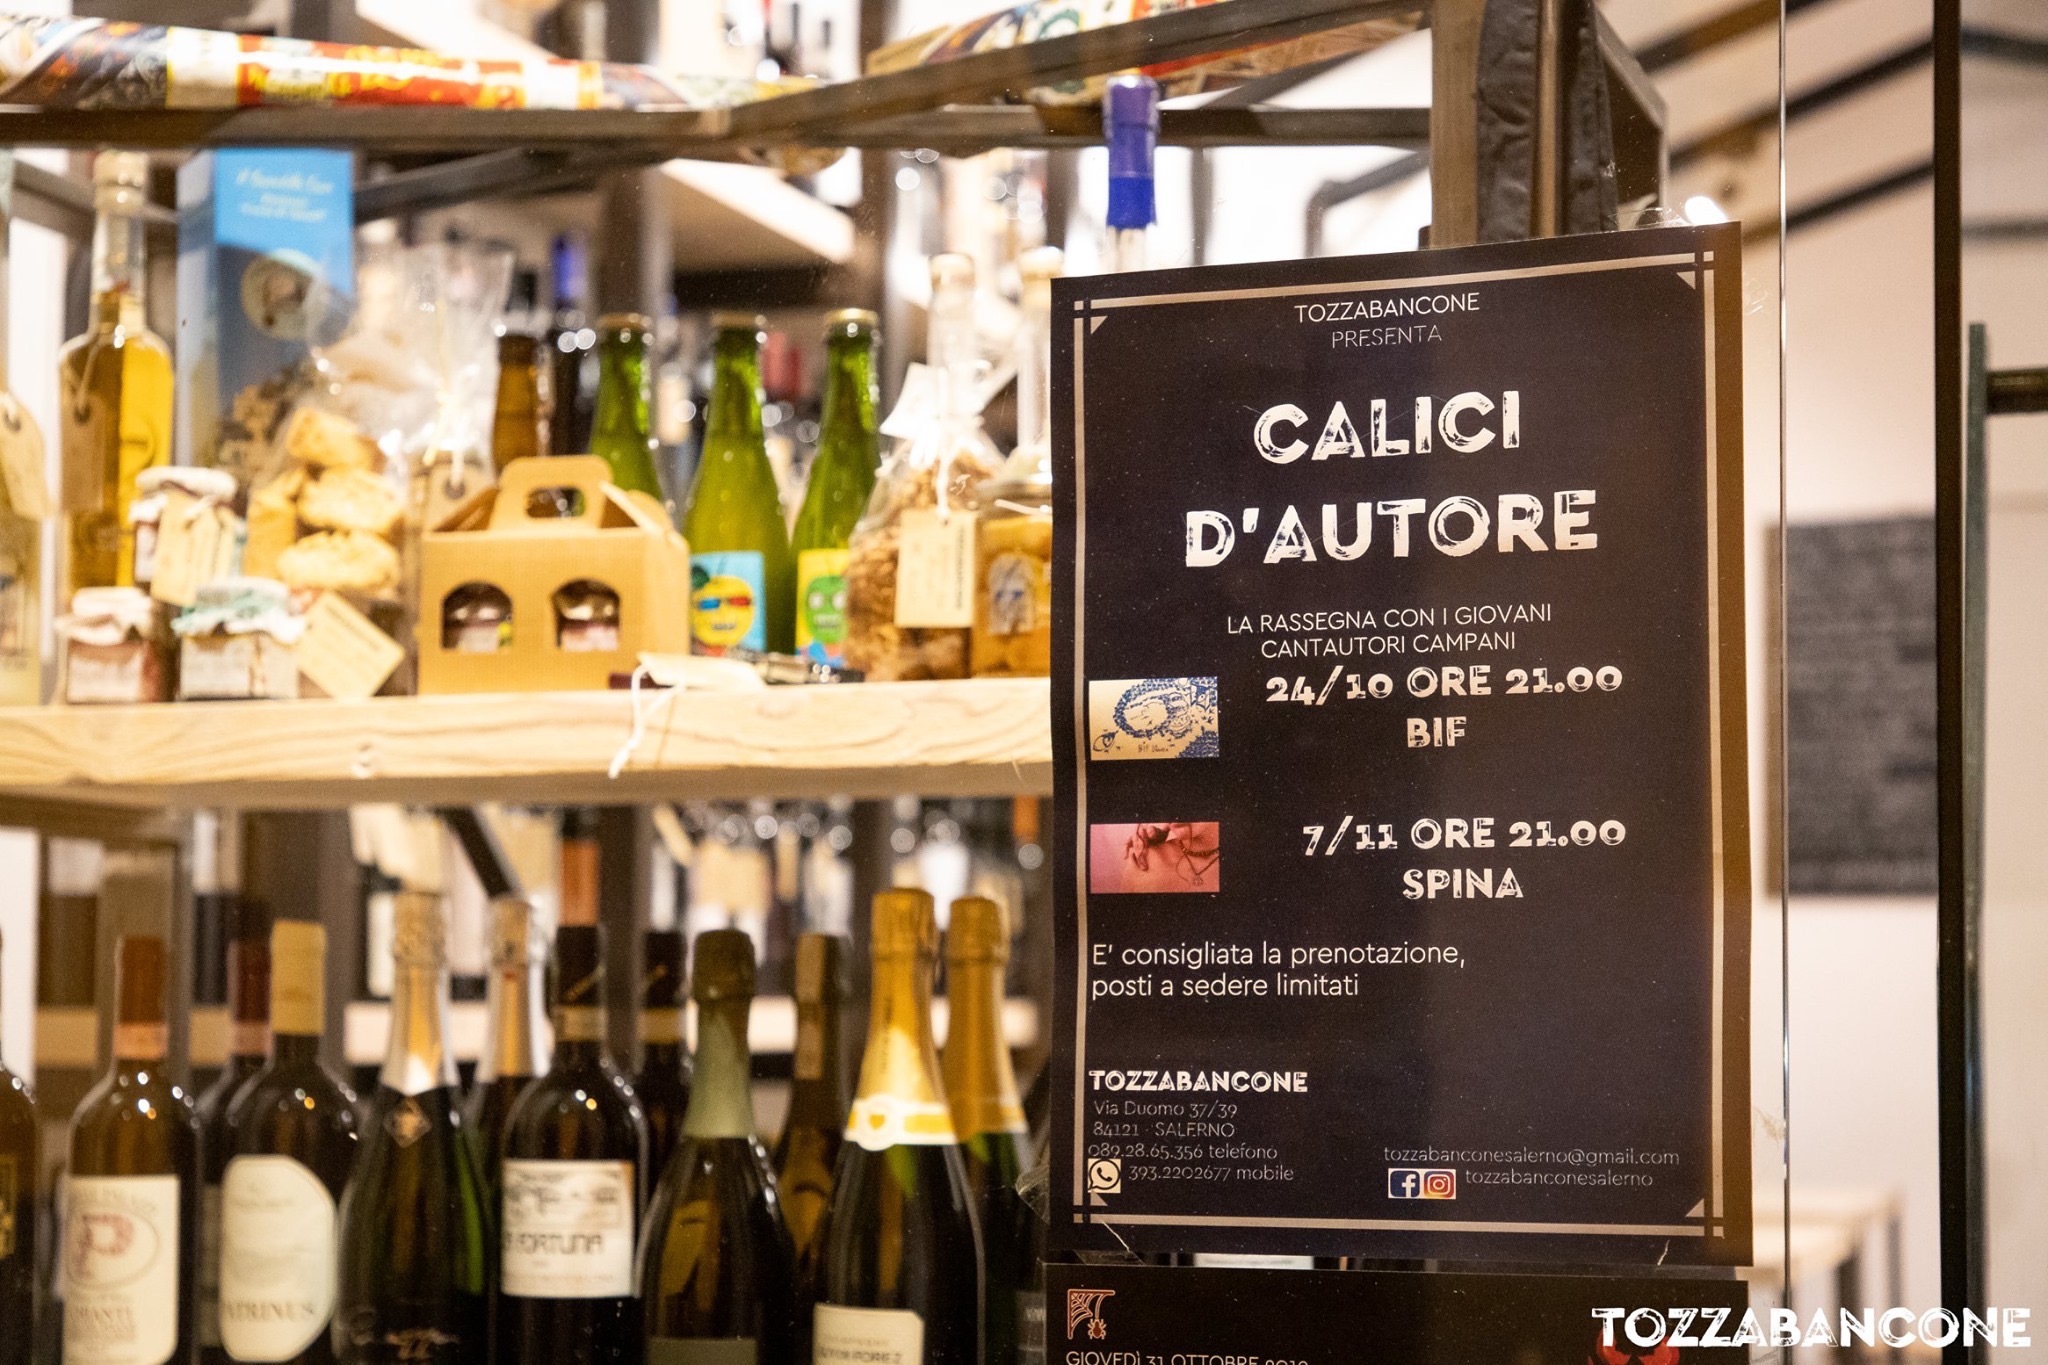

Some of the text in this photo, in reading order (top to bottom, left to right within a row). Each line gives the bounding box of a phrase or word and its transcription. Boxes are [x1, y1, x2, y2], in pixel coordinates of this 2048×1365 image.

[1294, 292, 1480, 324] TOZZABANCONE
[1331, 326, 1442, 348] PRESENTA
[1253, 390, 1520, 464] CALICI
[1185, 489, 1598, 567] D'AUTORE
[1227, 615, 1255, 633] LA
[1260, 611, 1377, 632] RASSEGNA
[1384, 608, 1435, 627] CON
[1455, 604, 1551, 625] GIOVANI
[1260, 631, 1516, 659] CANTAUTORI CAMPANI
[1265, 665, 1623, 706] 24/10 ORE 21.00
[1407, 716, 1466, 748] BIF
[1303, 815, 1627, 856] 7/11 ORE 21.00
[1402, 868, 1523, 900] SPINA
[1092, 942, 1465, 971] E' consigliata la prenotazione,
[1092, 973, 1359, 1001] posti a sedere limitati
[1088, 1070, 1308, 1092] TOZZABANCONE
[1094, 1100, 1237, 1119] Via Duomo 37/39
[1093, 1122, 1235, 1137] 84121 SALERNO
[1088, 1143, 1277, 1159] 089.28.65.356 telefono
[1384, 1146, 1679, 1166] tozzabanconesalerno@gmail.com
[1128, 1165, 1294, 1181] 393.2202677 mobile
[1466, 1169, 1653, 1186] tozzabanconesalerno
[1171, 1354, 1259, 1365] OTTOBRE
